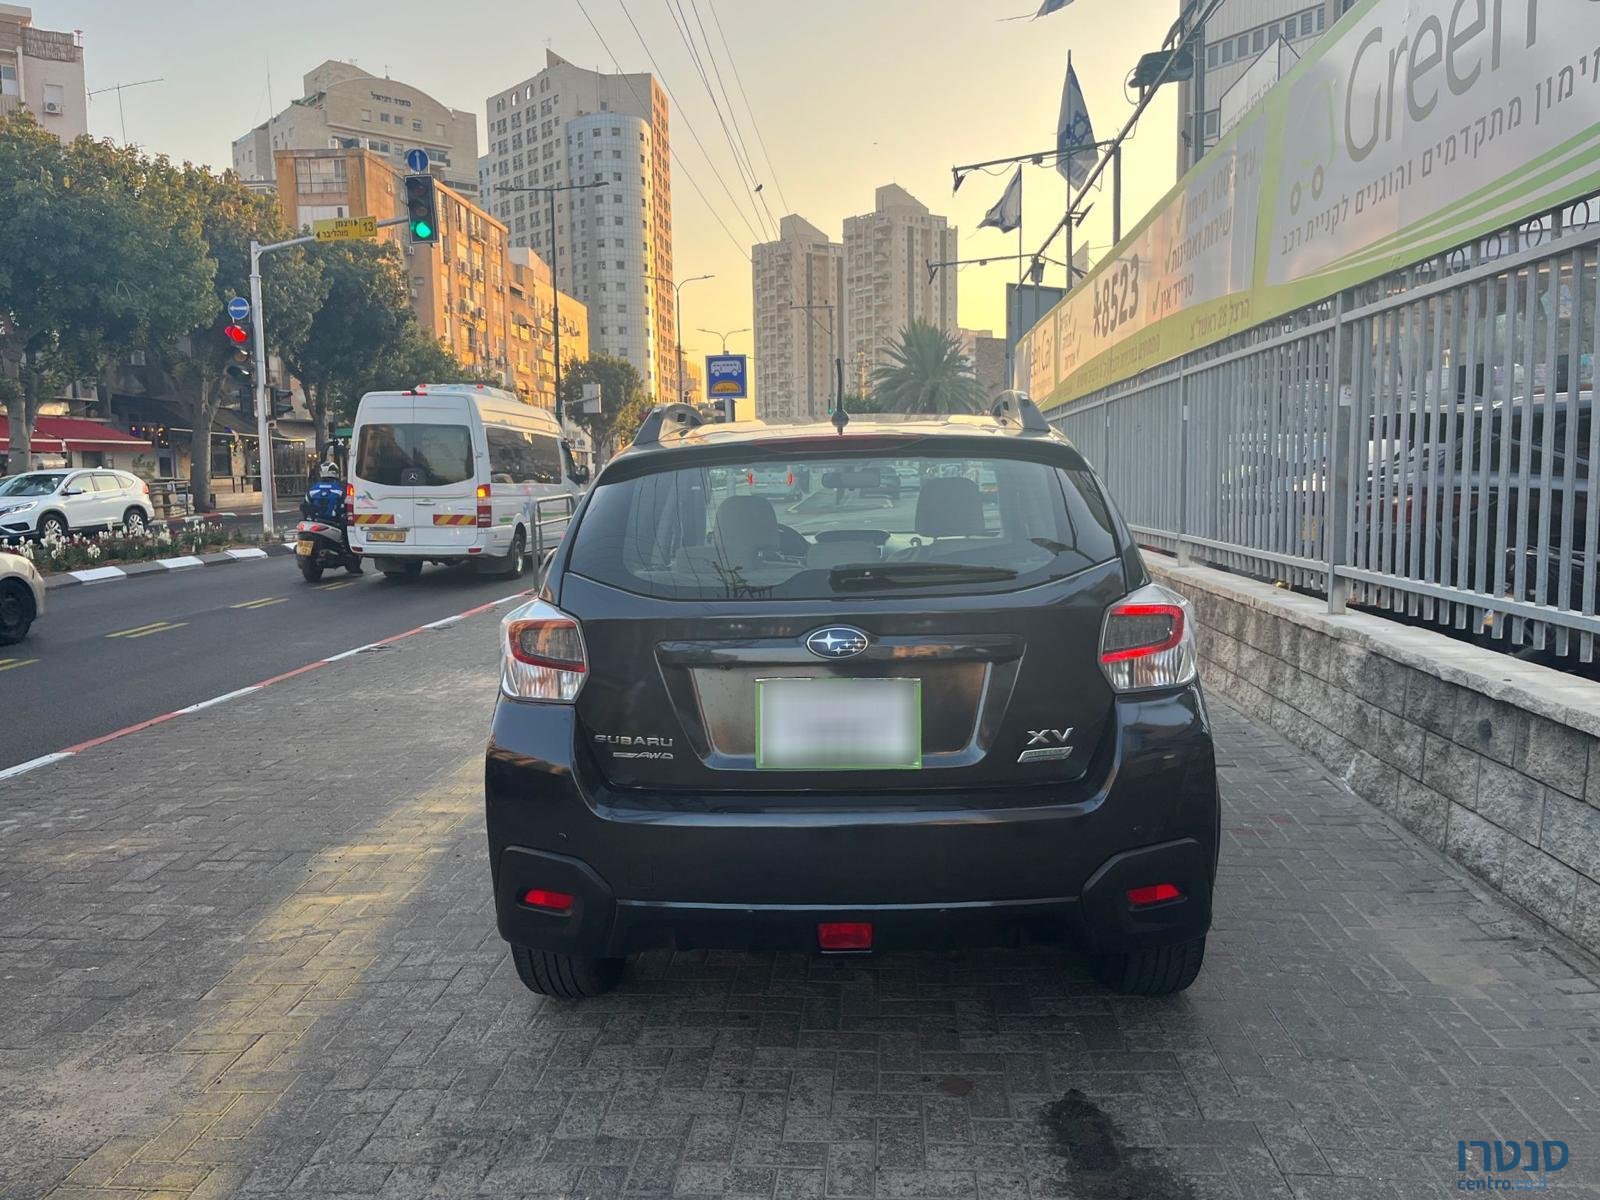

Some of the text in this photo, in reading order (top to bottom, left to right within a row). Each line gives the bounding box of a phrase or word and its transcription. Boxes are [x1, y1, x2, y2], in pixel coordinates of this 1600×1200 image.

[1345, 0, 1538, 163] Green
[1422, 95, 1522, 178] מתקדמים
[1354, 159, 1413, 215] והוגנים
[363, 221, 374, 232] 13
[1305, 194, 1349, 240] לקניית
[1281, 226, 1302, 256] רכב
[593, 734, 674, 747] SUBARU
[1027, 727, 1074, 745] XV
